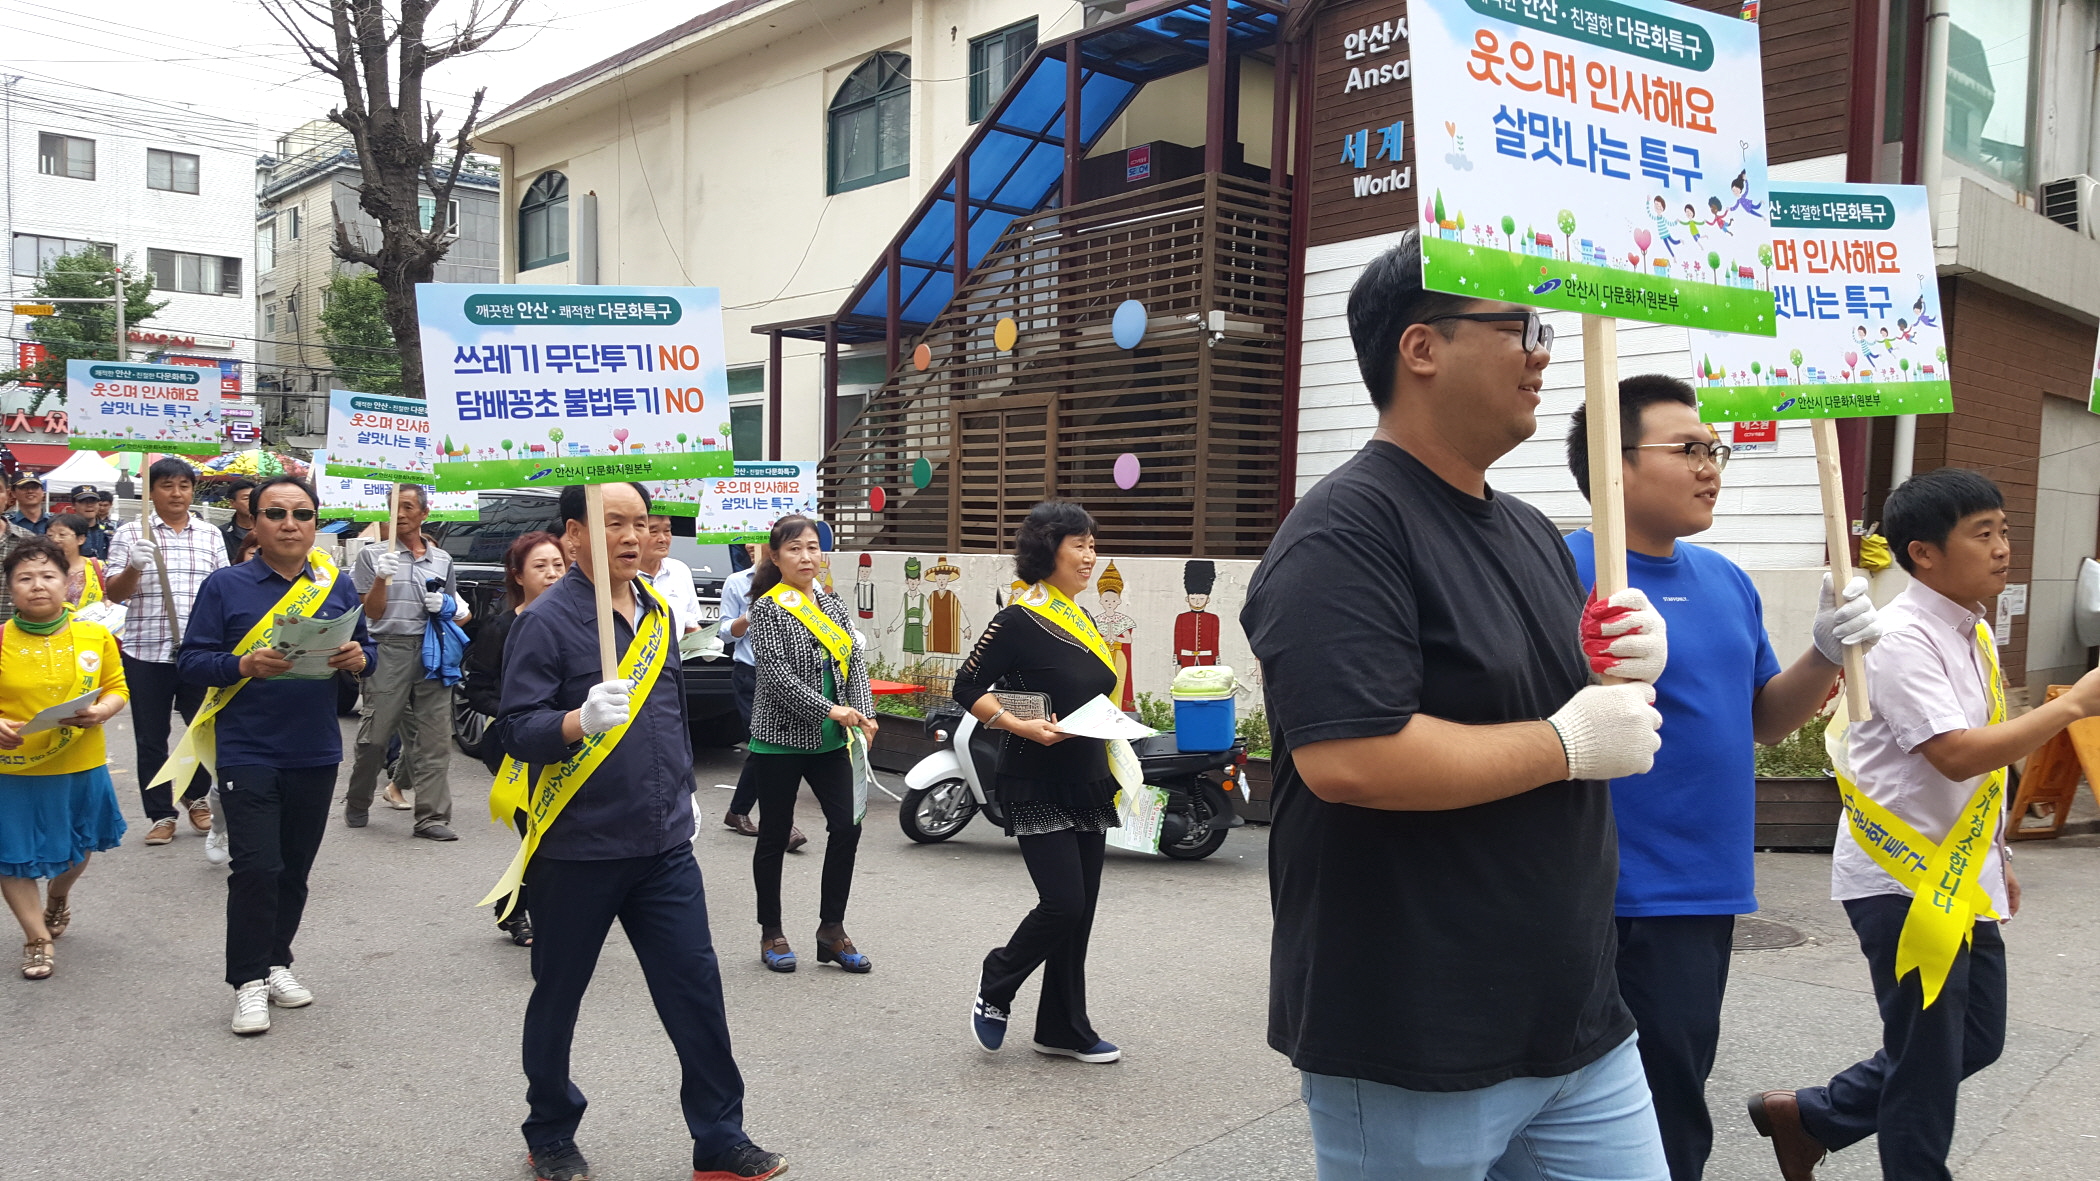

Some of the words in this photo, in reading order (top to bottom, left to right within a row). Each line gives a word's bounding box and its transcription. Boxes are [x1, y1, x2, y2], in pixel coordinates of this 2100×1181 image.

[1570, 7, 1613, 38] 친절한
[1616, 17, 1703, 61] 다문화특구
[1344, 59, 1410, 94] Ansa
[1466, 28, 1578, 104] 웃으며
[1585, 61, 1718, 135] 인사해요
[1492, 103, 1632, 181] 살맛나는
[1638, 135, 1703, 193] 특구
[1353, 166, 1411, 198] World
[1769, 203, 1782, 221] 산
[1789, 204, 1821, 221] 친절한
[1822, 203, 1887, 224] 다문화특구
[1803, 239, 1901, 275] 인사해요
[1564, 277, 1600, 301] 안산시
[1602, 283, 1680, 313] 다문화지원본부
[1774, 284, 1842, 321] 맛나는
[1845, 285, 1893, 320] 특구
[475, 304, 514, 319] 깨끗한
[517, 301, 549, 319] 안산
[558, 304, 595, 319] 쾌적한
[598, 301, 672, 321] 다문화특구
[453, 344, 539, 375] 쓰레기
[545, 343, 654, 374] 무단투기
[658, 344, 700, 371] NO
[115, 369, 132, 378] 안산
[155, 372, 195, 382] 다문화특구
[90, 382, 138, 398] 웃으며
[141, 385, 200, 402] 인사해요
[1797, 395, 1823, 409] 안산시
[1824, 393, 1881, 409] 다문화지원본부
[100, 400, 160, 417] 살맛나는
[163, 403, 192, 418] 특구
[373, 401, 389, 410] 안산
[455, 388, 560, 421] 담배꽁초
[563, 386, 659, 416] 불법투기
[665, 387, 704, 414] NO
[350, 412, 392, 430] 웃으며
[357, 430, 412, 449] 살맛나는
[414, 436, 431, 450] 특
[1732, 444, 1757, 452] SECOM
[555, 464, 585, 479] 안산시
[586, 462, 653, 478] 다문화지원본부
[765, 467, 796, 476] 다문화특구
[713, 480, 751, 494] 웃으며
[753, 480, 800, 494] 인사해요
[721, 496, 769, 510] 살맛나는
[771, 496, 794, 510] 특구
[1842, 792, 1928, 874] 다문화특구
